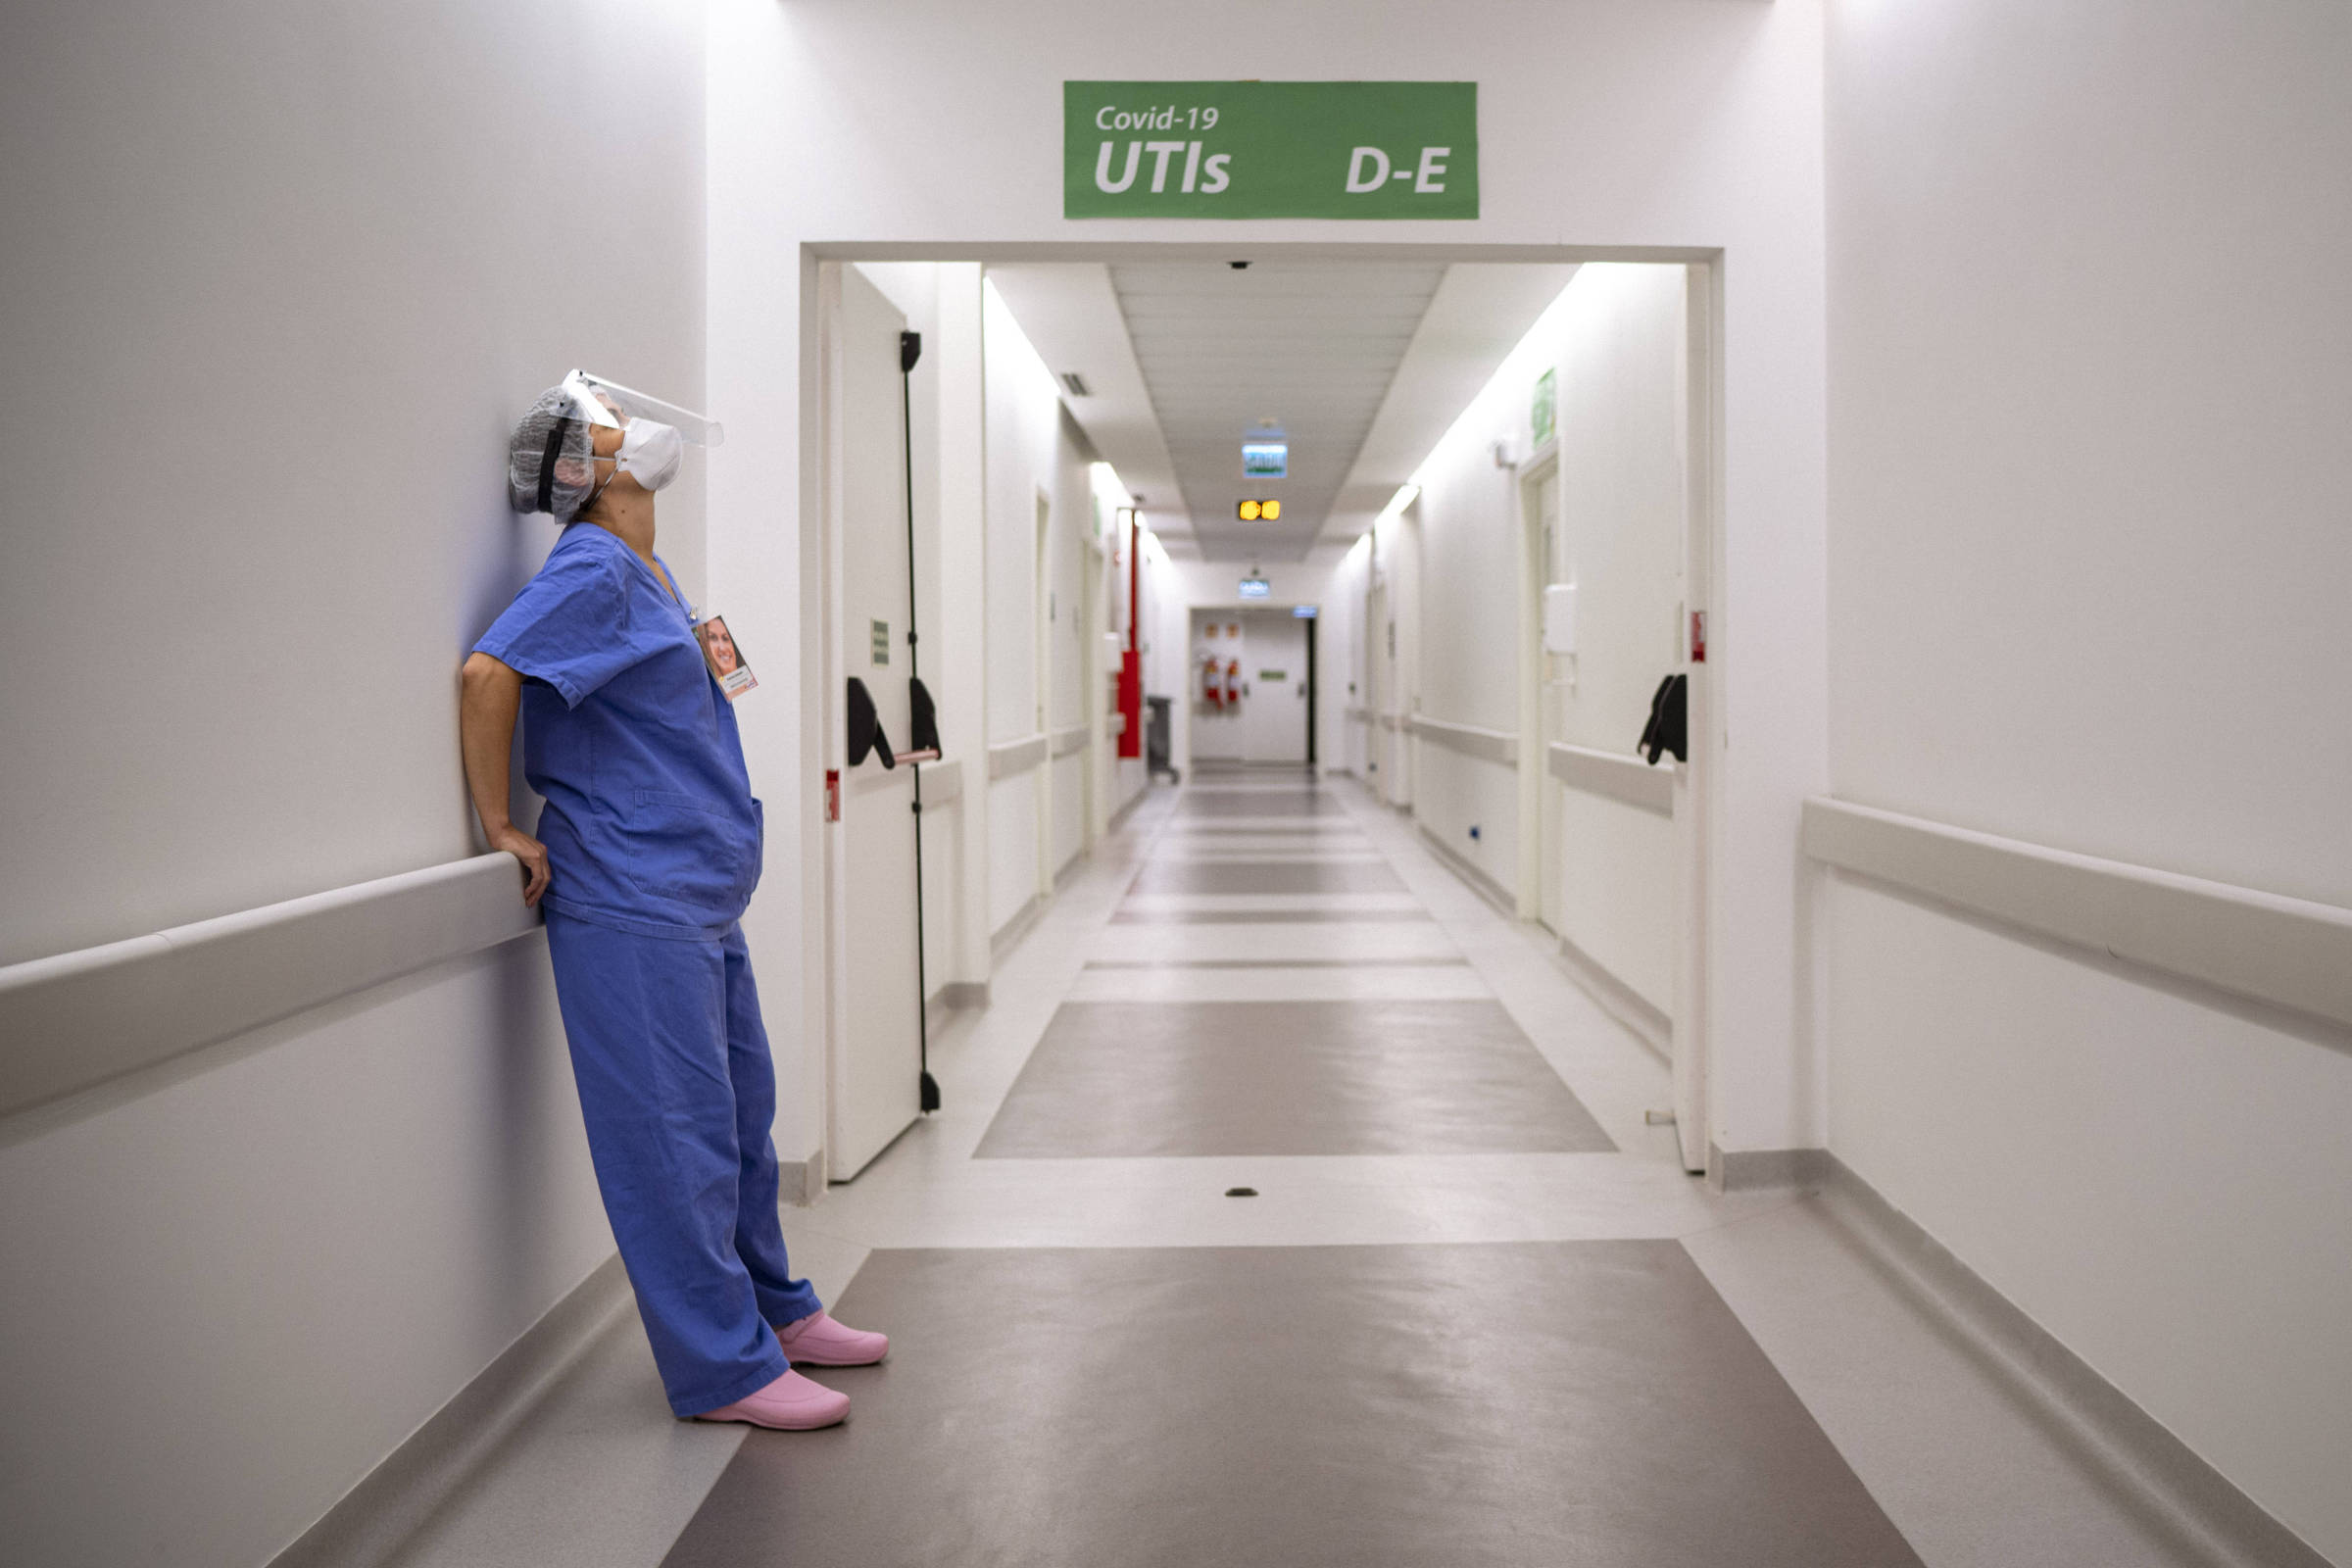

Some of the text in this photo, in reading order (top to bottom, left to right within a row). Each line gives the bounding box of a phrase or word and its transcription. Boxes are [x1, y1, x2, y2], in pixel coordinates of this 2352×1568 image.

[1096, 105, 1219, 130] Covid-19
[1095, 140, 1451, 194] UTIs D-E
